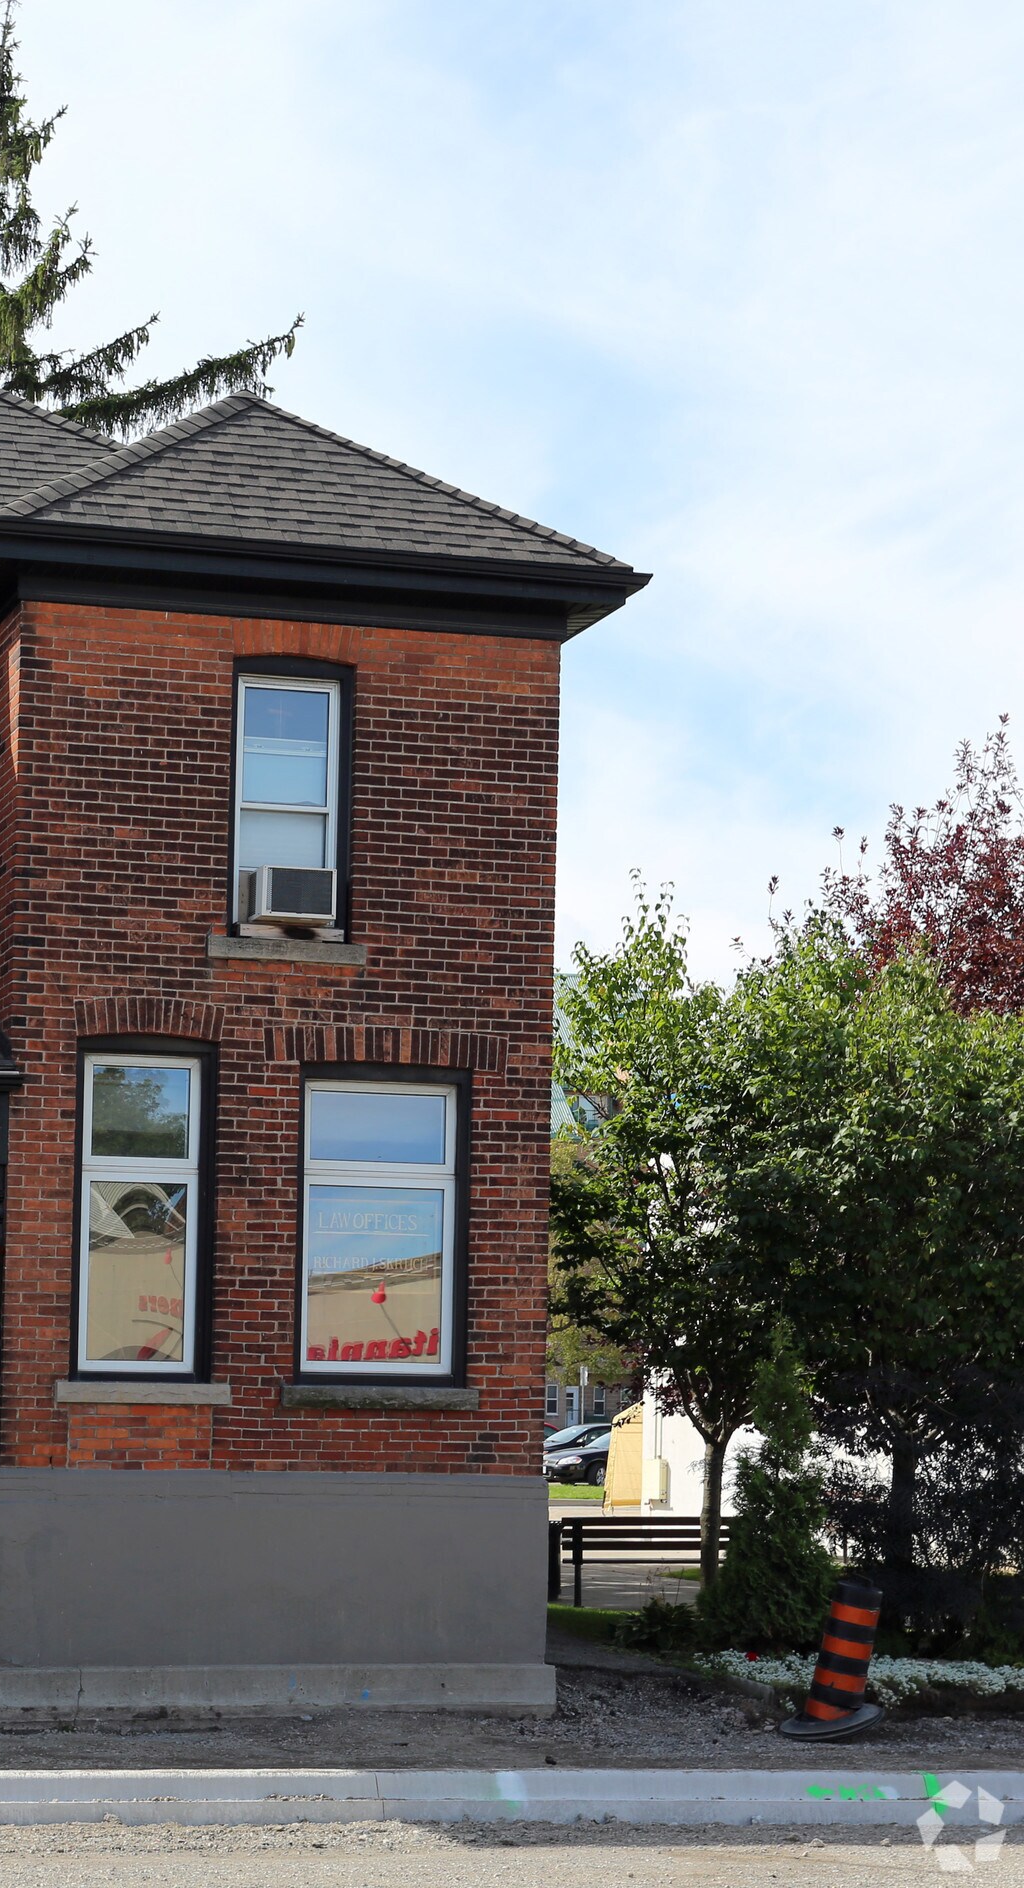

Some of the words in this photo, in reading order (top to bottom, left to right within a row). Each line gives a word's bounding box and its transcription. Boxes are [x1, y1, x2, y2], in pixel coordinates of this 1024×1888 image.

[319, 1213, 350, 1228] LAW
[353, 1213, 417, 1231] OFFICES
[314, 1256, 368, 1268] RICHARD
